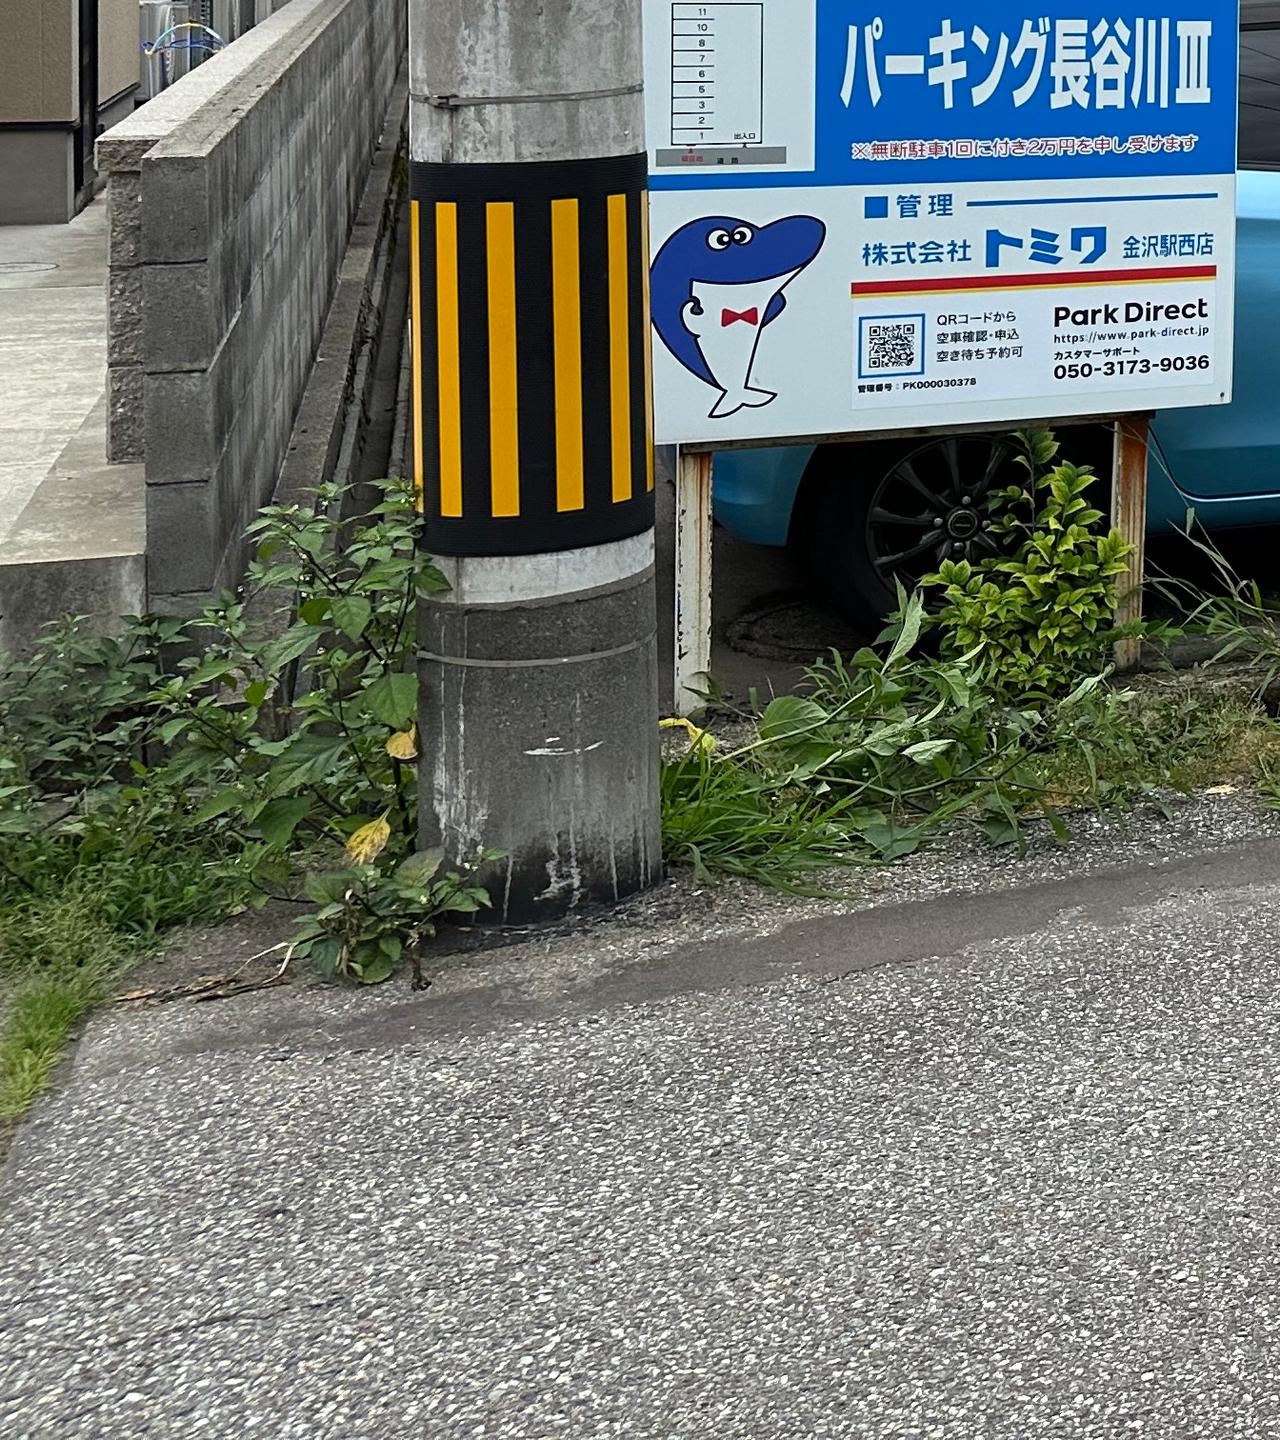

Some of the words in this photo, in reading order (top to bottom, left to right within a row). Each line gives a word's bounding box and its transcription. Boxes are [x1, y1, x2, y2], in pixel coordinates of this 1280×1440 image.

[699, 39, 705, 47] 8
[699, 101, 705, 109] 3
[734, 132, 756, 140] 出入口
[862, 239, 972, 267] 株式会社
[985, 226, 1107, 268] トミワ
[1123, 232, 1214, 259] 金沢駅西店
[937, 311, 1016, 326] QRコードから
[1054, 304, 1119, 327] Park
[1125, 298, 1208, 323] Direct
[936, 329, 1019, 344] 空車確認・申込
[1054, 325, 1209, 343] https://www.park-direct.jp
[936, 346, 1023, 362] 空き待ち予約可
[1054, 346, 1140, 361] カスタマーサポート
[1053, 355, 1210, 379] 050-3173-9036
